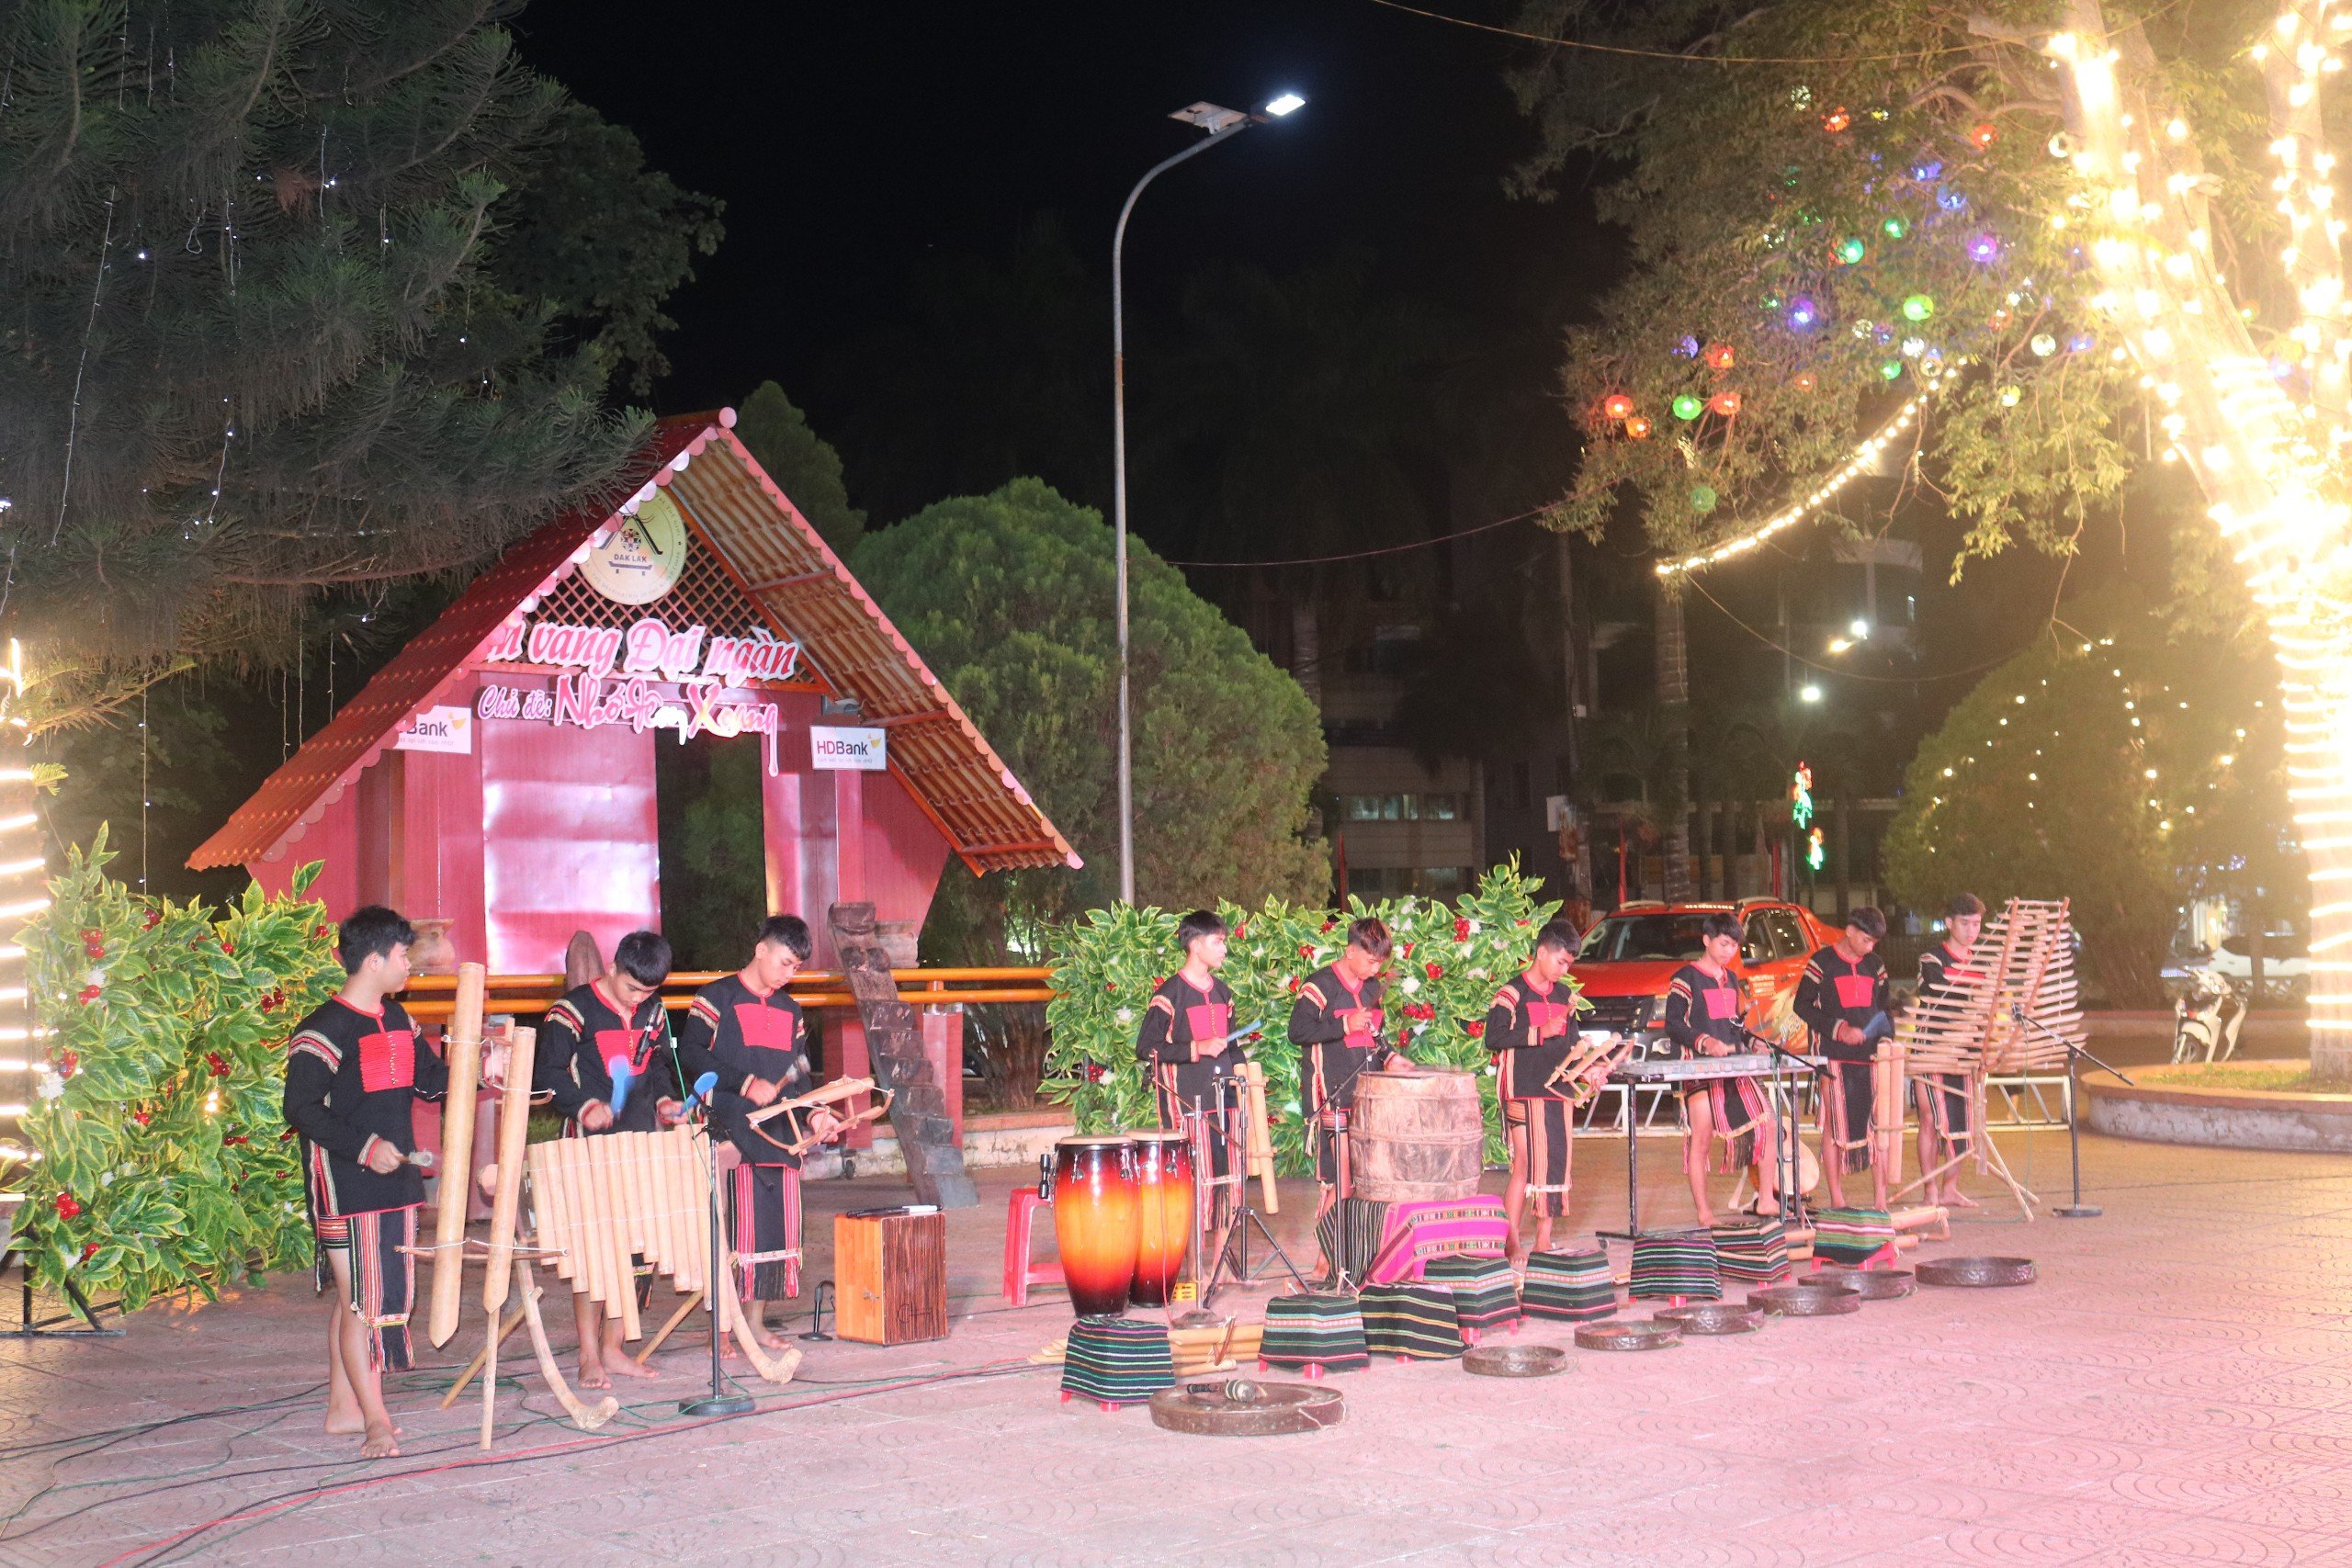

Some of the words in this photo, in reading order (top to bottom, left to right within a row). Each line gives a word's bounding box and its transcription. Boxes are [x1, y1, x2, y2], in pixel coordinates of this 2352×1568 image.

[614, 553, 630, 561] DAK
[632, 554, 647, 562] LAK
[529, 623, 622, 678] vang
[626, 618, 705, 681] Đại
[704, 626, 799, 688] ngàn
[479, 685, 520, 719] Chủ
[817, 740, 868, 755] HDBank
